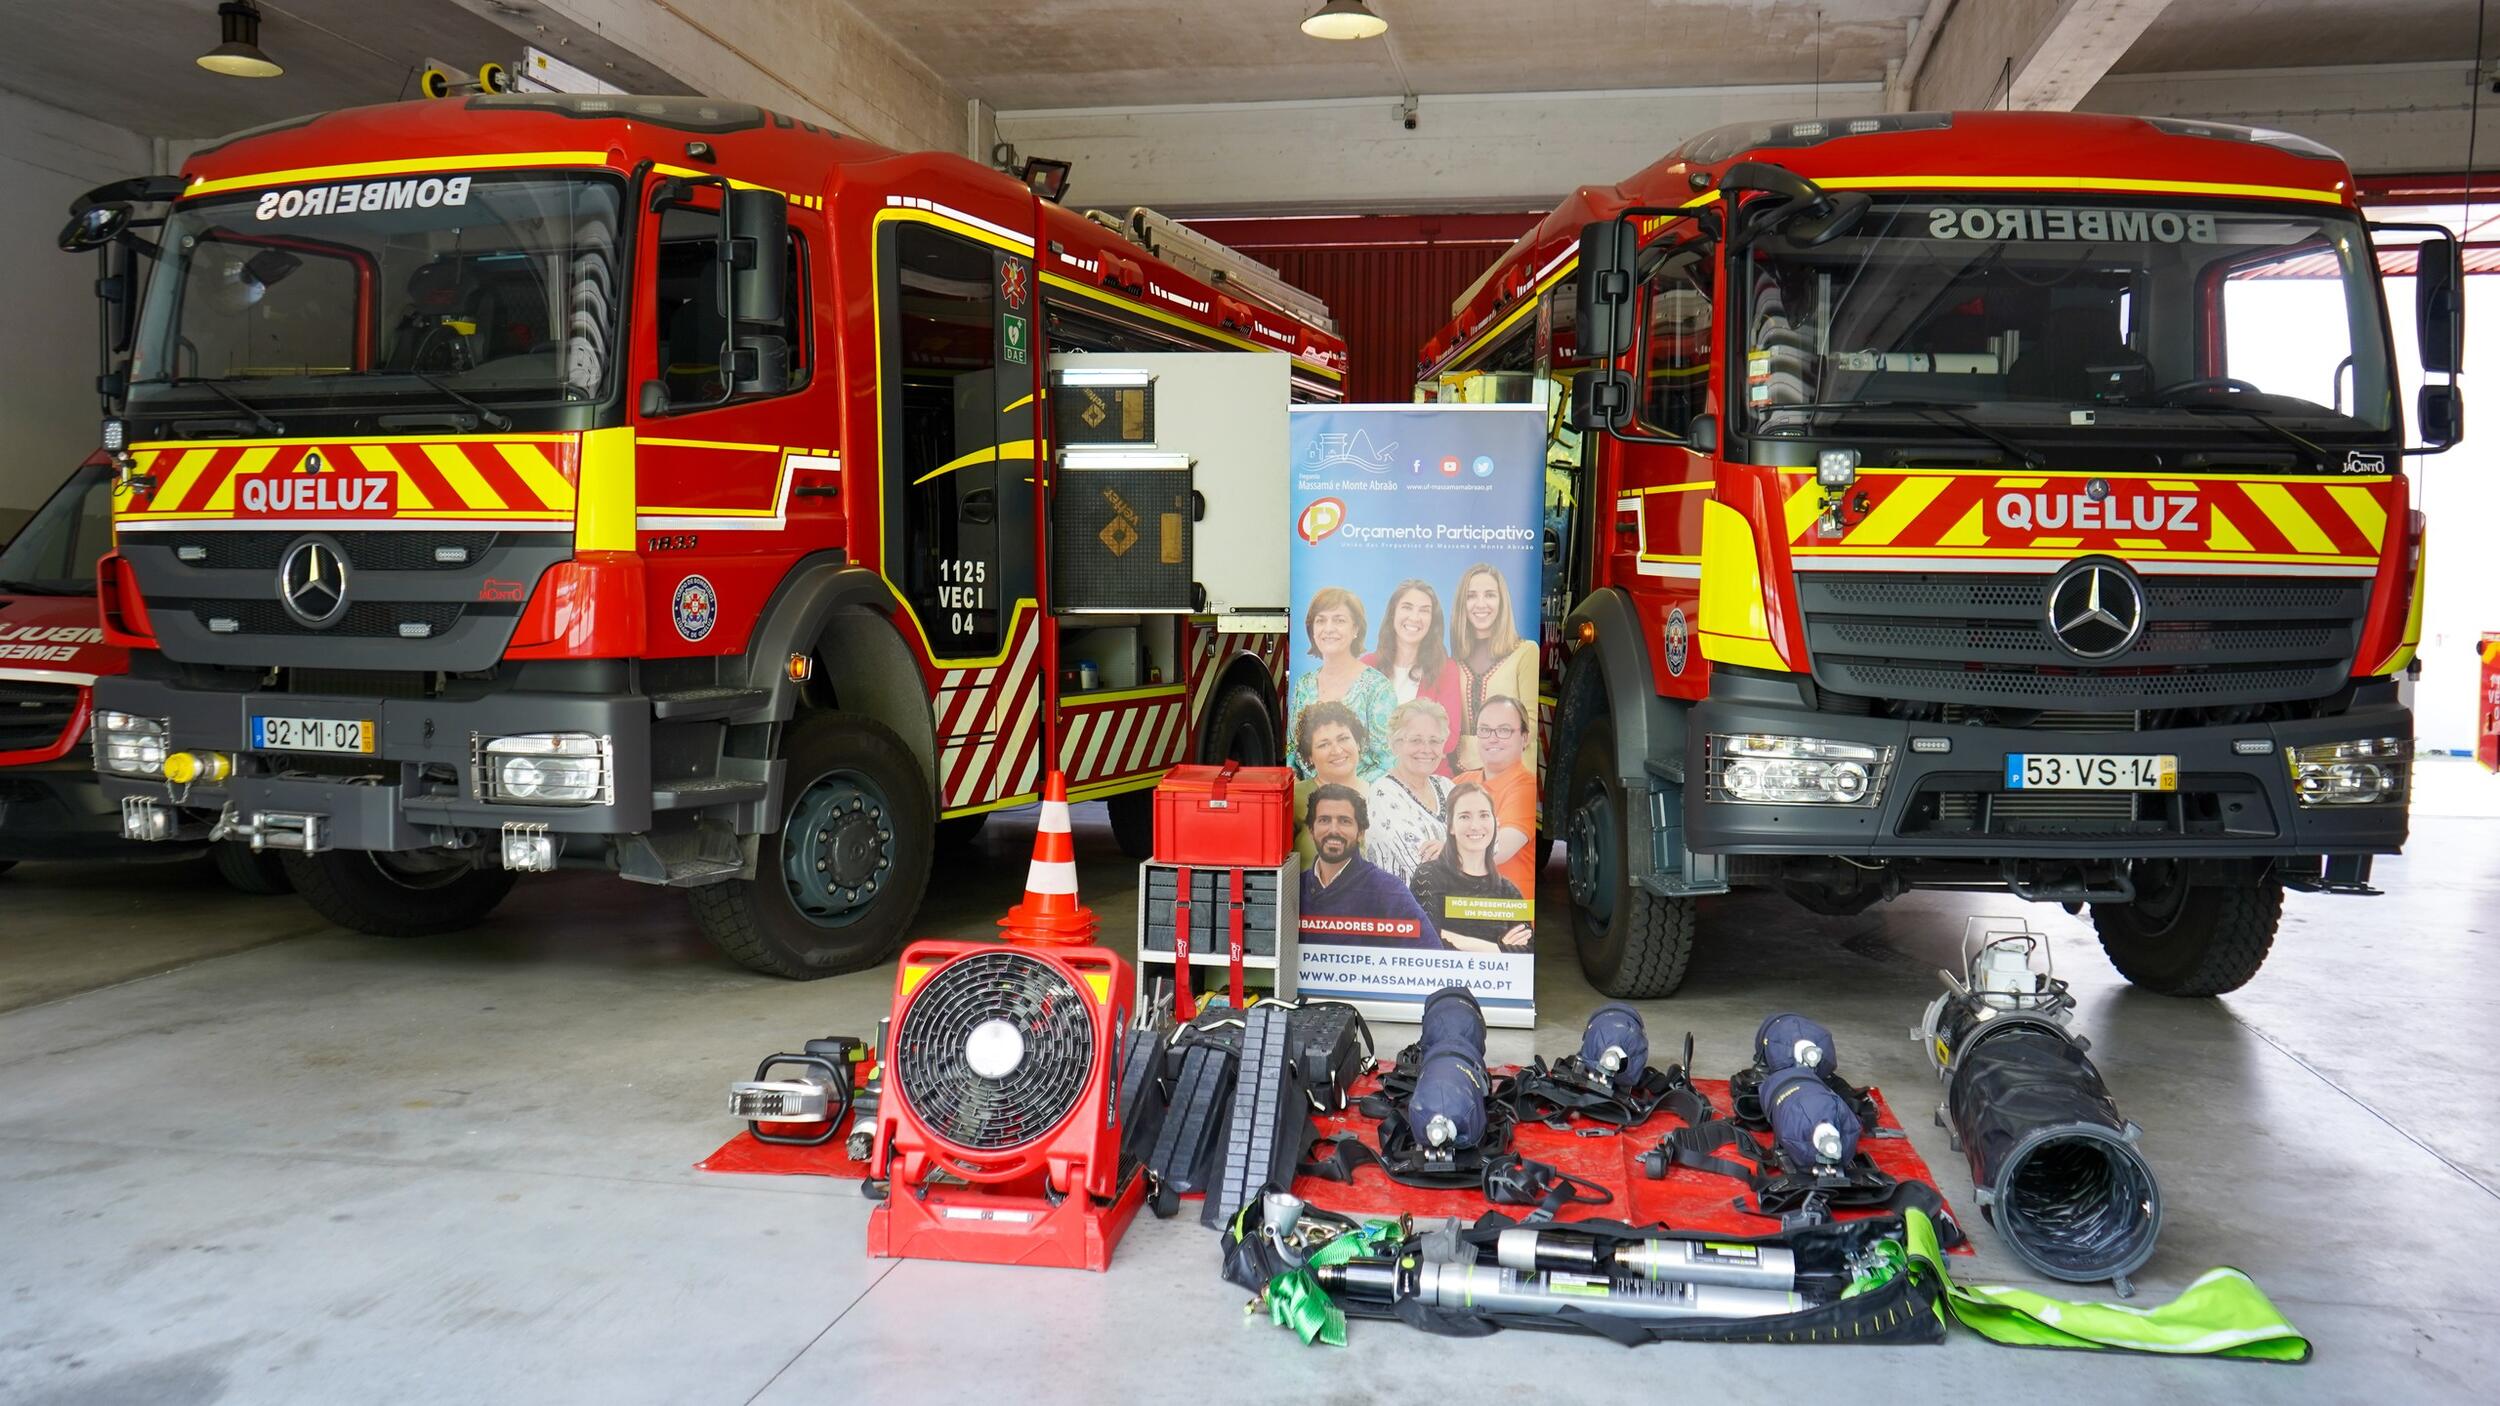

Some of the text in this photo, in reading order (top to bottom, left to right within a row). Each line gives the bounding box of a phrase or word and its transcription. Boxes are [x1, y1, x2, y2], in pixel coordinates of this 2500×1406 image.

[1007, 348, 1024, 362] DAE
[1298, 479, 1398, 491] Massamá e Monte Abraão
[243, 477, 389, 514] QUELUZ
[1996, 492, 2199, 532] QUELUZ
[1341, 523, 1535, 543] Orçamento Participativo
[940, 559, 986, 583] 1125
[938, 586, 983, 609] VECI
[951, 612, 974, 635] 04
[2012, 774, 2020, 783] P
[2163, 777, 2173, 787] 12
[1377, 922, 1394, 933] DO
[1397, 923, 1414, 933] OP
[1303, 952, 1509, 972] PARTICIPE, A FREGUESIA É SUA!
